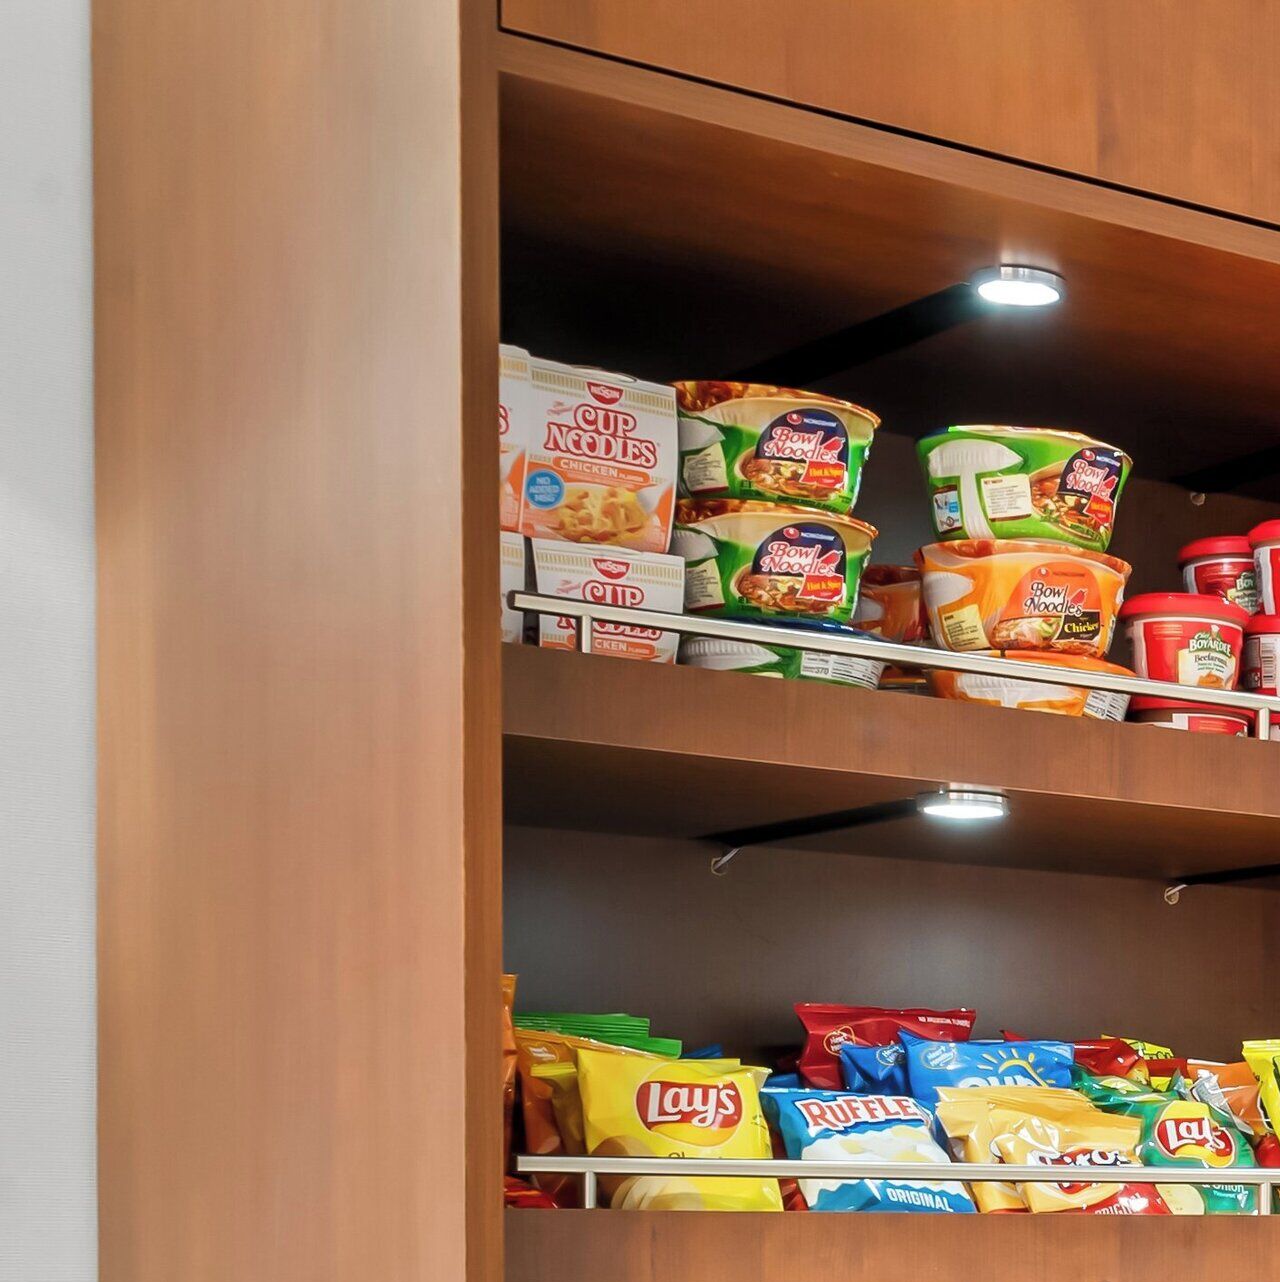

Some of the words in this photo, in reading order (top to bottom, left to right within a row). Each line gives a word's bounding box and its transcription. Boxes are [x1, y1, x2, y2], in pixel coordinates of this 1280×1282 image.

[574, 404, 637, 436] CUP
[544, 422, 658, 469] NOODLES
[772, 426, 824, 445] Bowl
[764, 441, 839, 464] Noodles
[560, 460, 619, 478] CHICKEN
[1073, 459, 1109, 478] Bowl
[1066, 472, 1111, 500] Noodles
[768, 541, 822, 559] Bowl
[760, 555, 837, 577] Noodles
[1031, 580, 1069, 598] Bowl
[1024, 597, 1083, 617] Noodles
[647, 1082, 736, 1127] Lay's
[799, 1095, 921, 1134] RUFFLE
[885, 1187, 955, 1213] ORIGINAL
